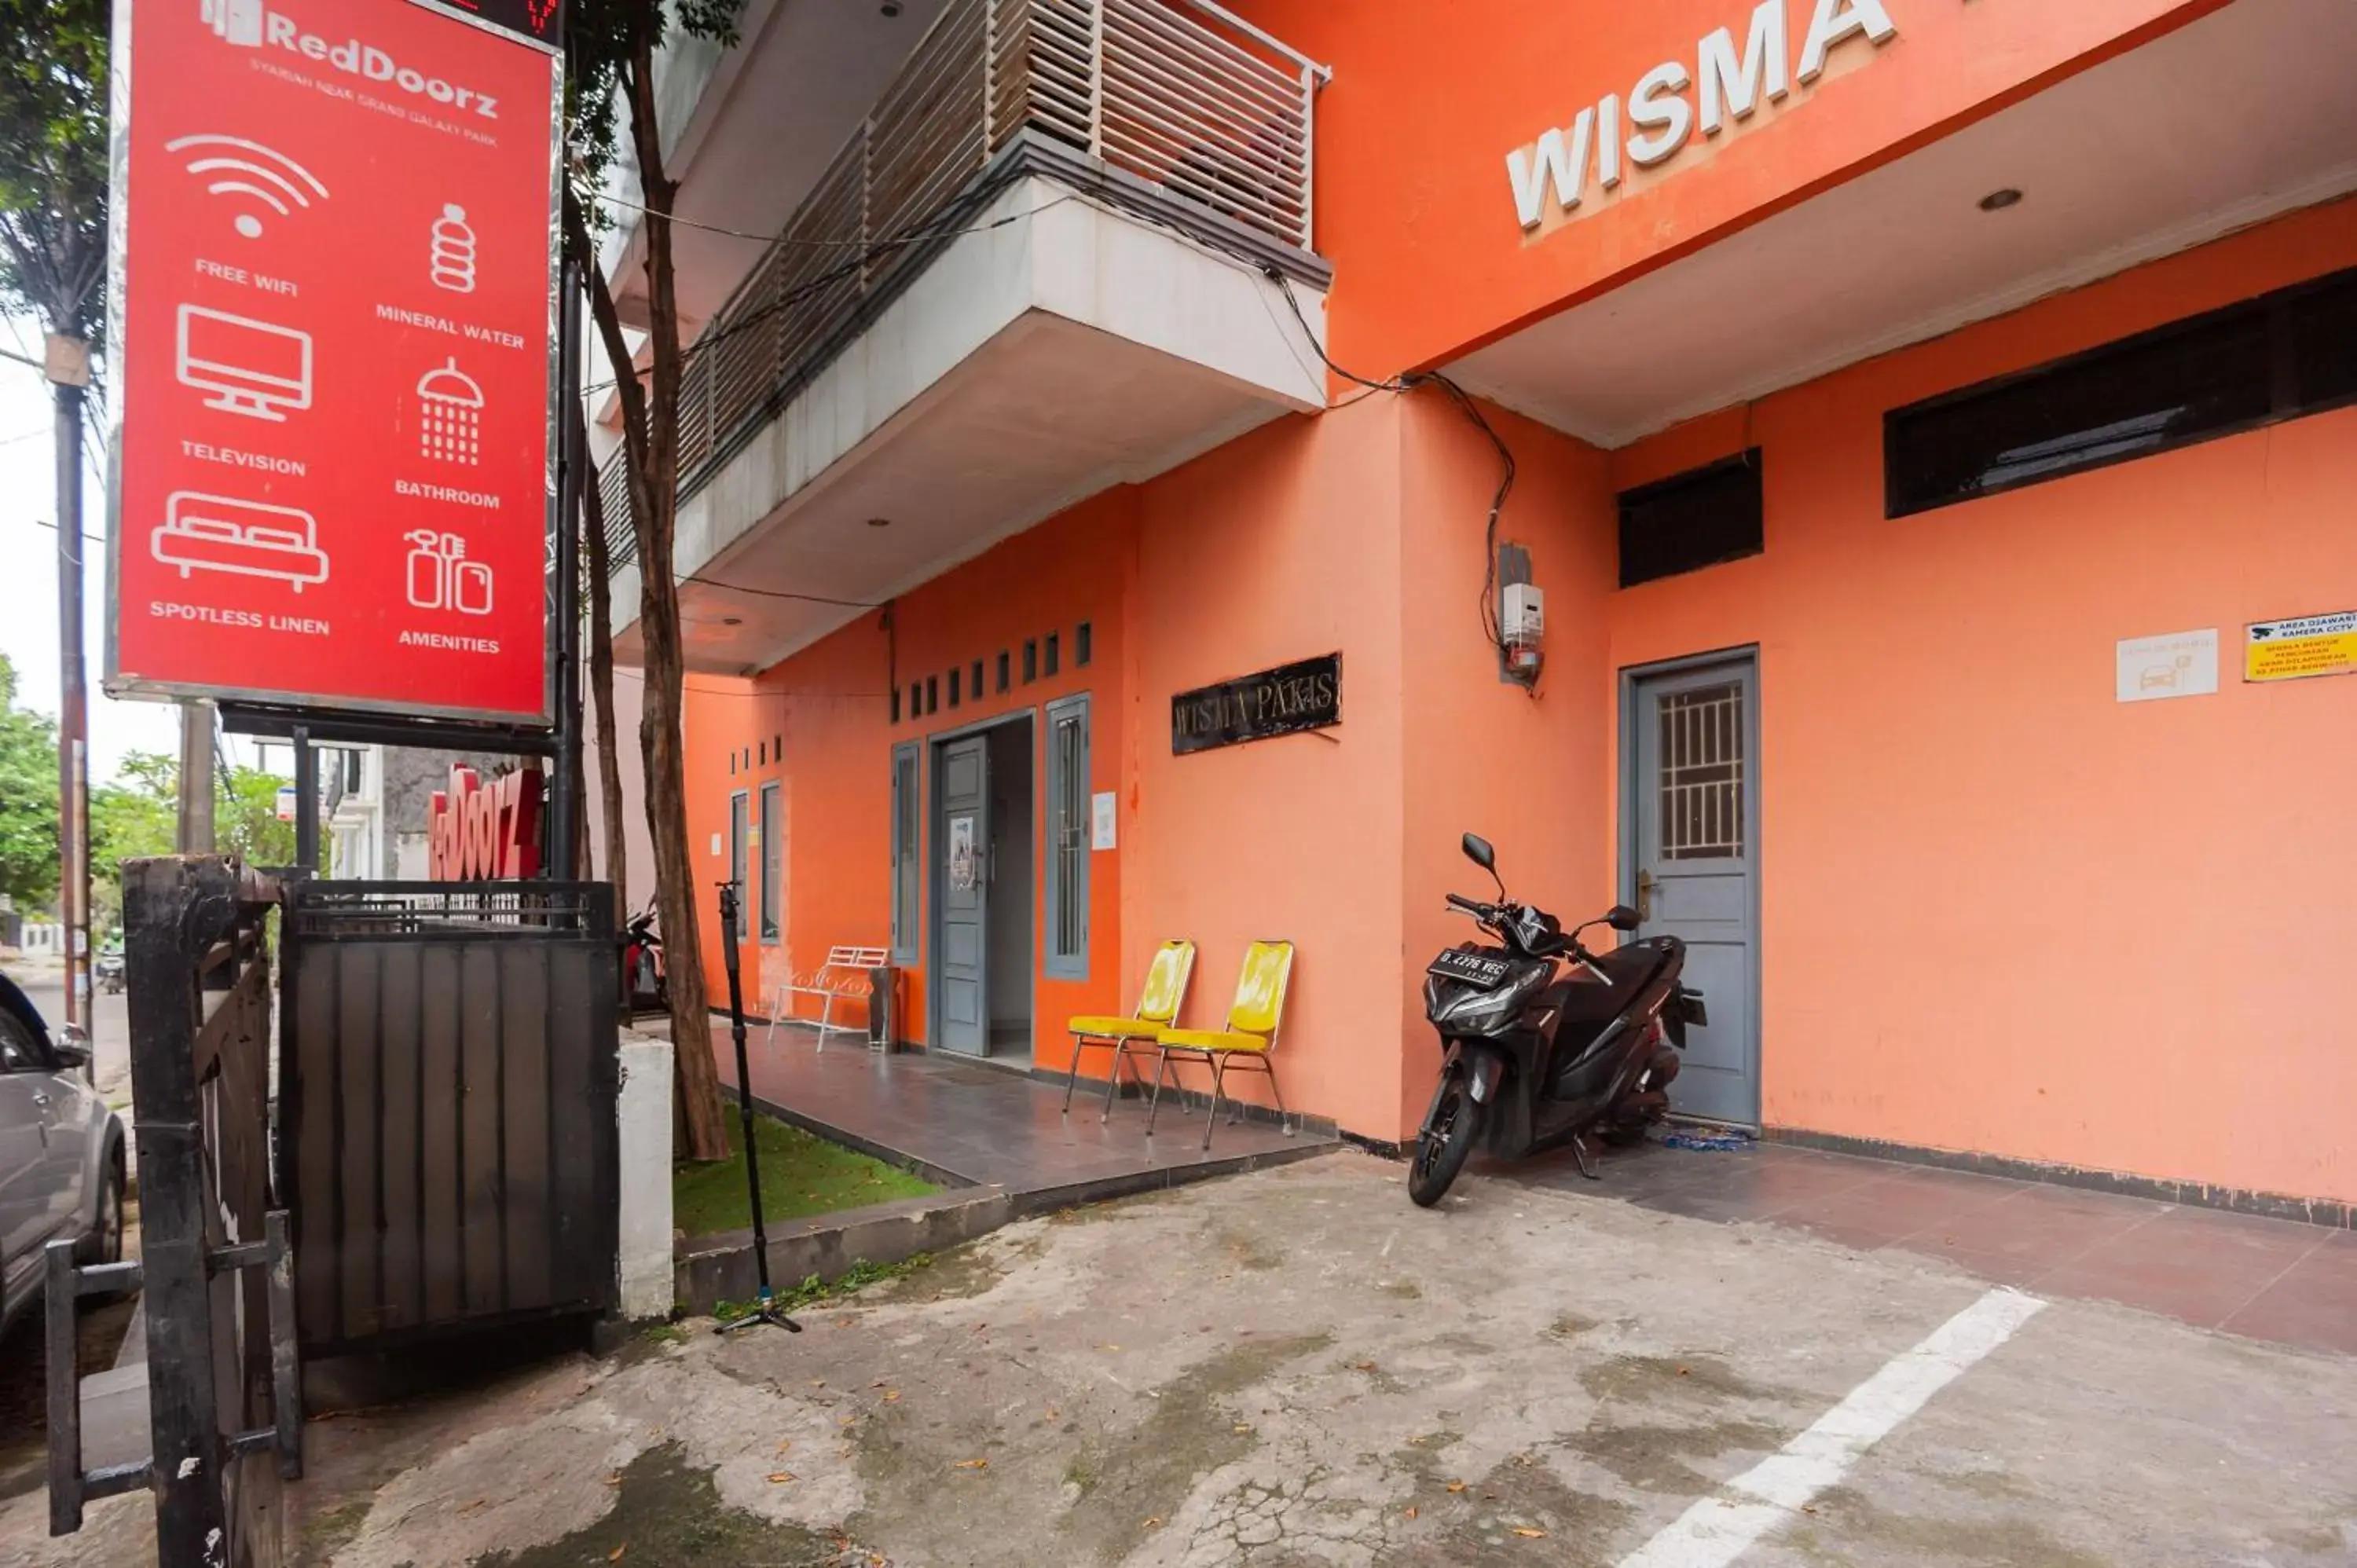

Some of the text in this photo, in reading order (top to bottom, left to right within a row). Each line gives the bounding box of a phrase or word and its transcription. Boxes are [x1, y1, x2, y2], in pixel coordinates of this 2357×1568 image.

[267, 11, 499, 119] RedDoorz
[316, 79, 354, 103] NEAR
[357, 93, 406, 119] GRAND
[462, 126, 498, 148] PARK
[1506, 0, 1897, 229] WISMA
[195, 258, 298, 298] FREE WIFI
[376, 303, 526, 350] MINERAL WATER
[181, 440, 306, 477] TELEVISION
[394, 479, 500, 509] BATHROOM
[150, 600, 330, 636] SPOTLESS LINEN
[2282, 623, 2353, 637] KAMERA CCTV
[399, 630, 500, 654] AMENITIES
